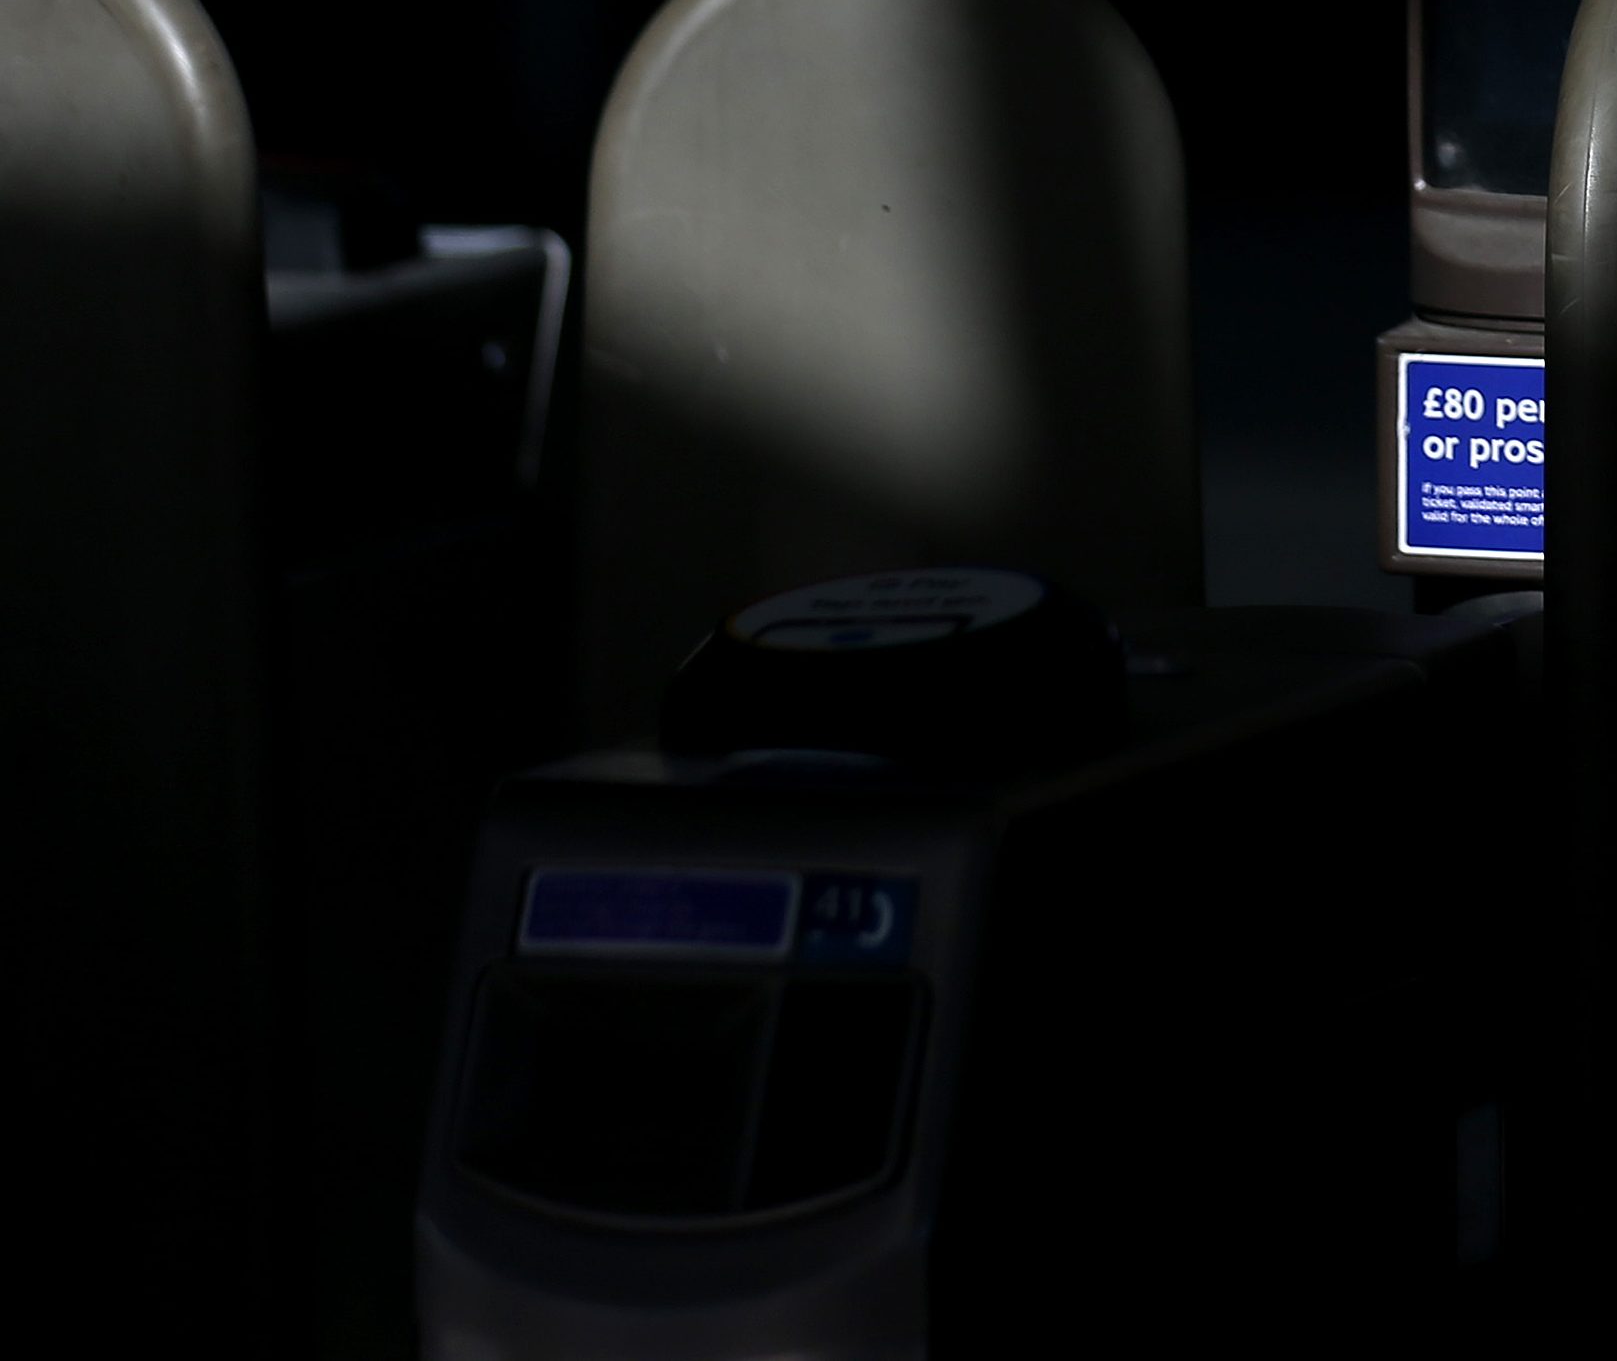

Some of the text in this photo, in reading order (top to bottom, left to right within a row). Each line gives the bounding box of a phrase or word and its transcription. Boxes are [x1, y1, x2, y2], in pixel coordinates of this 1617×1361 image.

[1423, 387, 1545, 429] £80 pe
[1423, 435, 1544, 469] or pros
[1432, 485, 1456, 496] you
[1456, 486, 1482, 497] pass
[1484, 485, 1507, 497] this
[1509, 486, 1540, 499] point
[1461, 498, 1513, 511] validated
[1421, 509, 1450, 522] valid
[1450, 510, 1469, 523] for
[1470, 512, 1492, 525] the
[1492, 513, 1529, 526] whole
